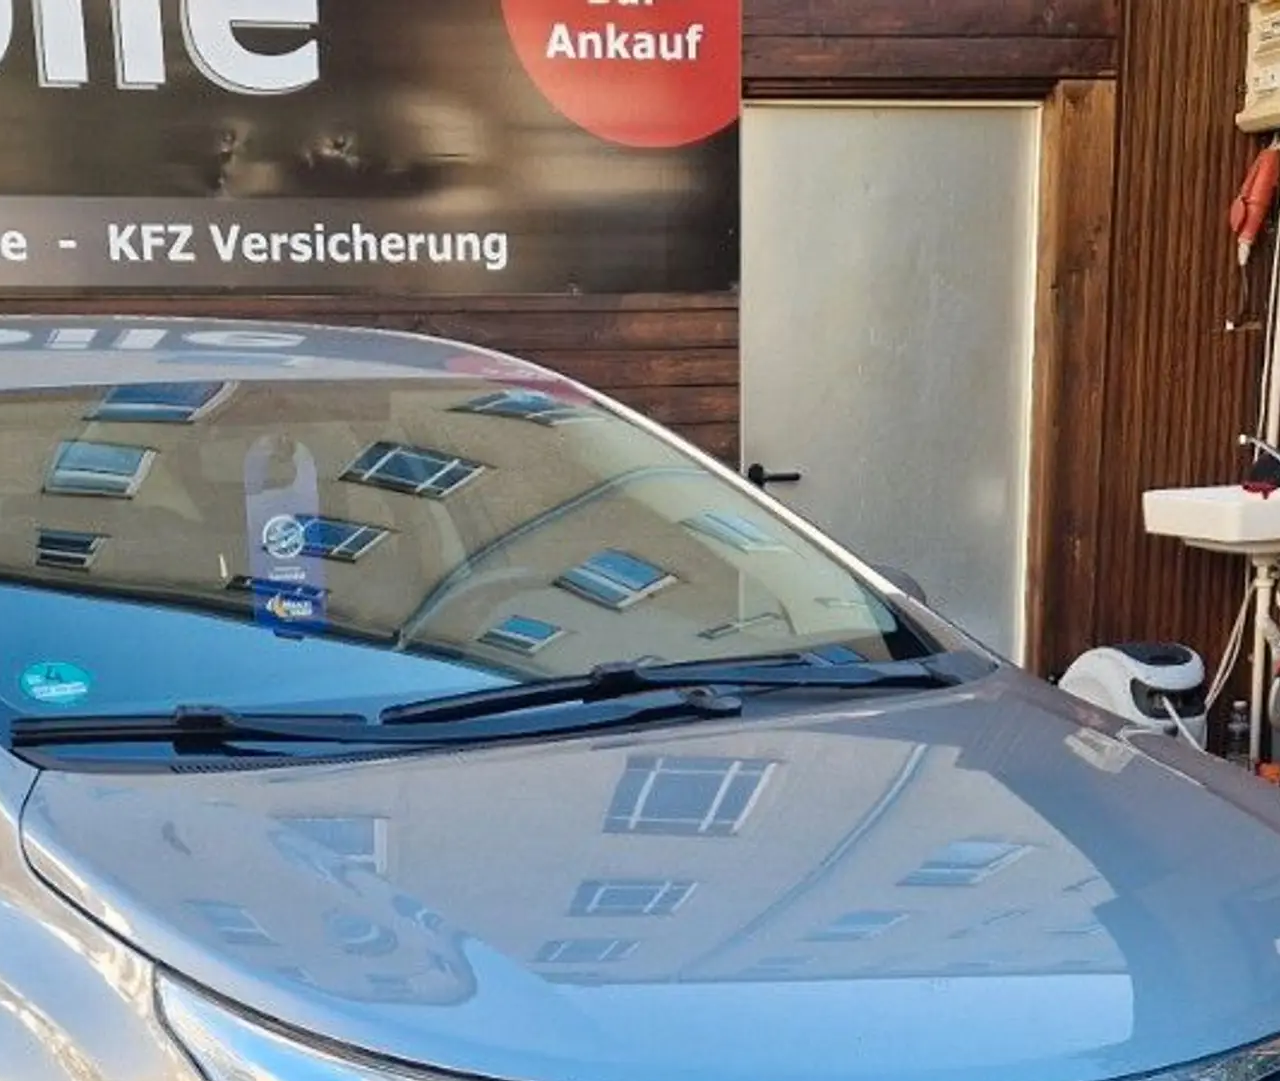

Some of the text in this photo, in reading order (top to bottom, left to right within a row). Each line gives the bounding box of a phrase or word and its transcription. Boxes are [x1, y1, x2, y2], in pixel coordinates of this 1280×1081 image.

[546, 23, 704, 61] Ankauf
[107, 225, 194, 261] KFZ
[210, 225, 508, 270] Versicherung
